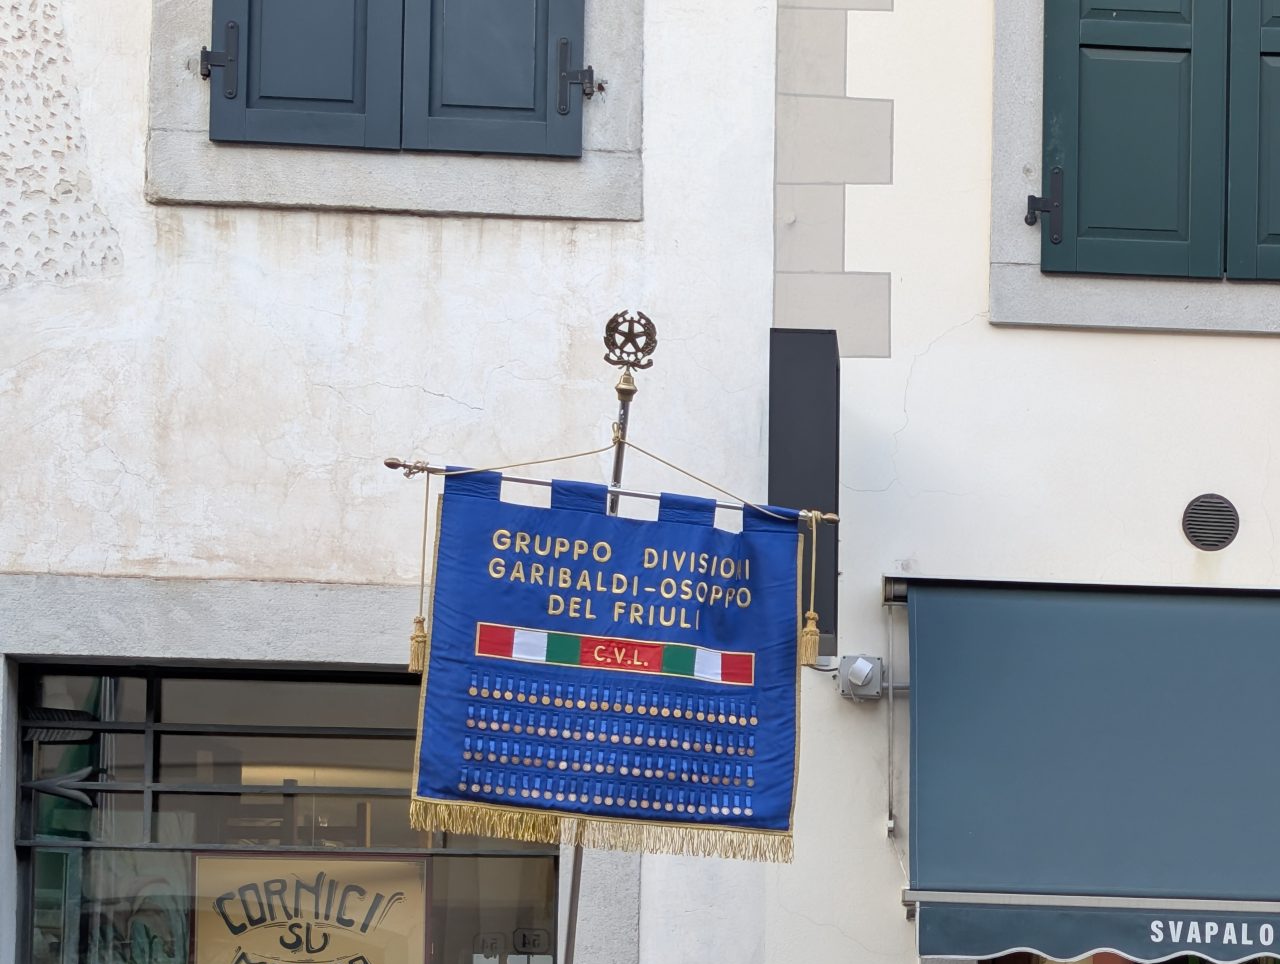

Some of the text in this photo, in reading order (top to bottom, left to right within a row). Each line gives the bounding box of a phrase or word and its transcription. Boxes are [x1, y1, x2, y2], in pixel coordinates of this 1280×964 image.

[492, 529, 750, 581] GRUPPO DIVISIOI
[488, 557, 752, 608] GARIBALDI-OSOPPO
[548, 594, 700, 631] DEL FRIULI
[593, 645, 649, 667] C.V.L.
[213, 871, 389, 936] CORNICI
[279, 922, 330, 954] SU
[1150, 920, 1275, 946] SVAPALO
